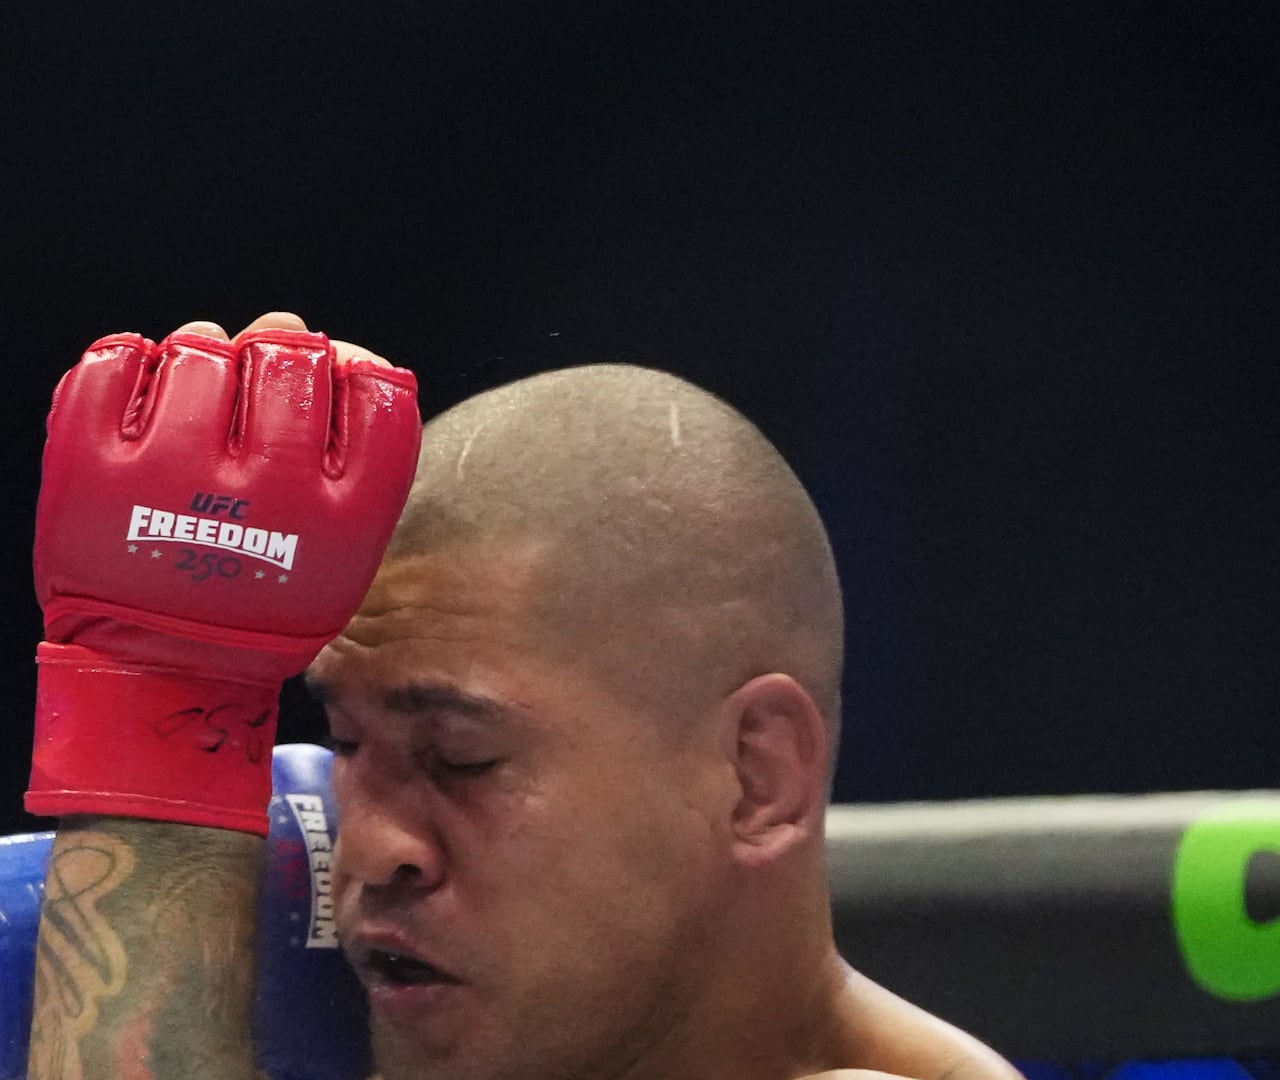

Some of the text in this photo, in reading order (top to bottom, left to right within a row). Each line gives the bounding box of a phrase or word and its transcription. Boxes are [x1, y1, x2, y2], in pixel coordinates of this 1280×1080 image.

[191, 492, 251, 519] UFC
[126, 504, 299, 570] FREEDOM
[173, 548, 243, 582] 250
